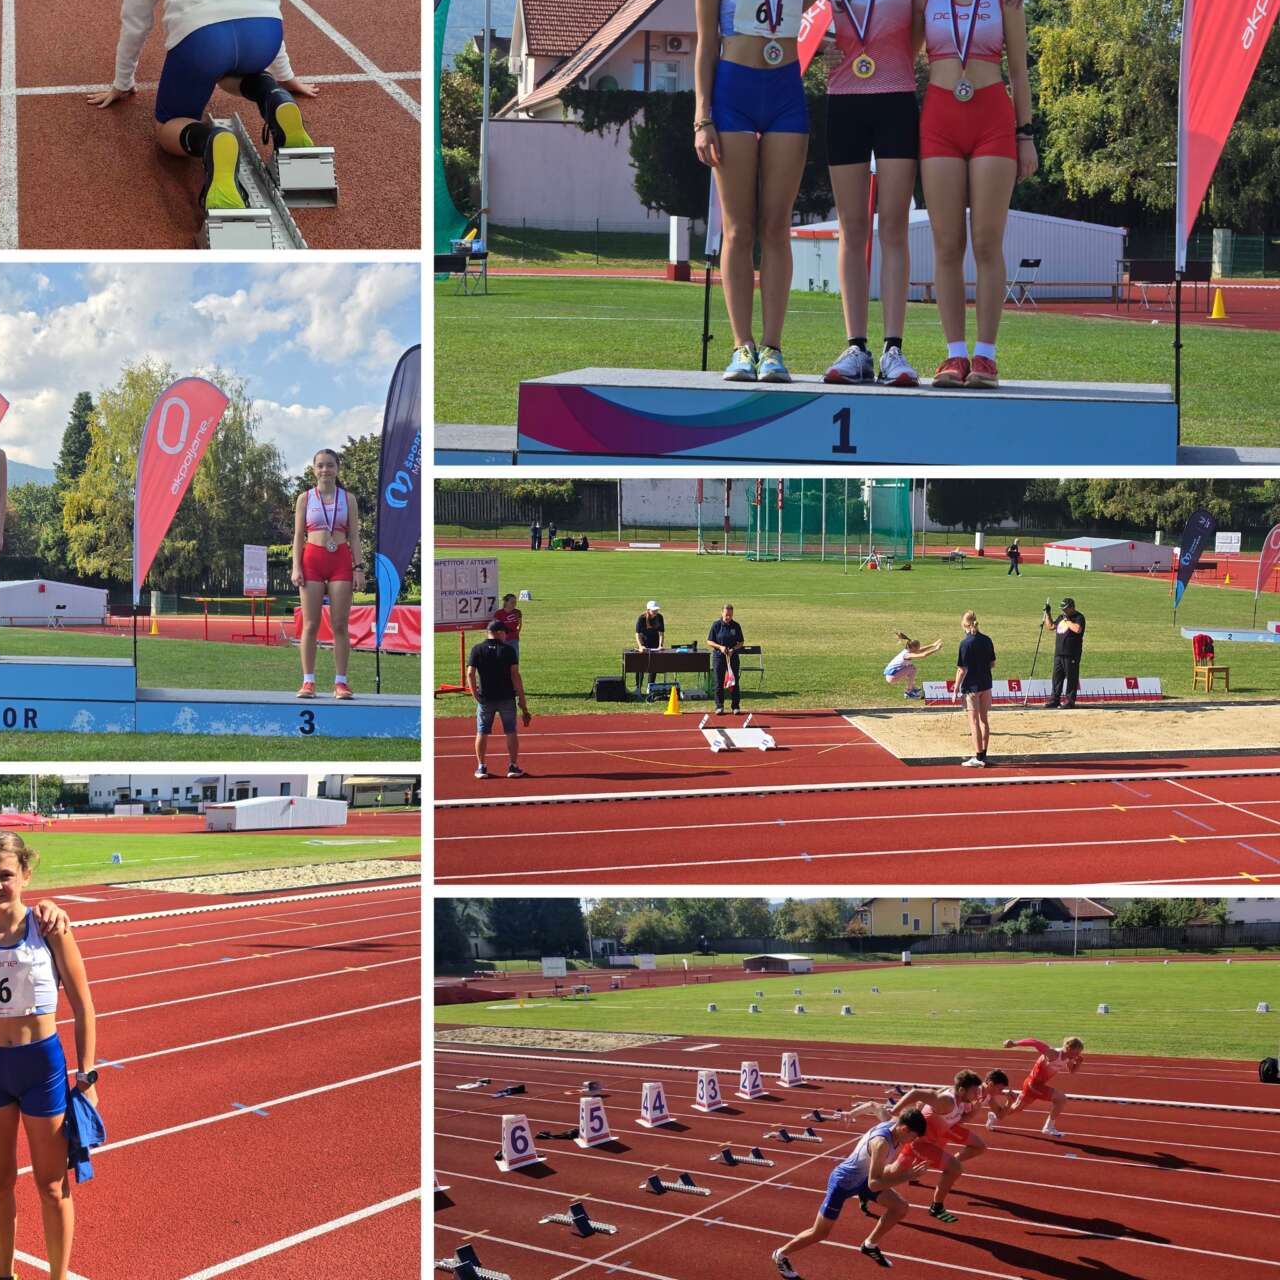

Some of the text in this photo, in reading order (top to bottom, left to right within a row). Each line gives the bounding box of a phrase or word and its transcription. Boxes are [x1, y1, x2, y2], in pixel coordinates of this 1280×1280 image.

[831, 407, 857, 444] 1
[480, 567, 488, 584] 1
[1128, 679, 1135, 688] 7
[299, 710, 317, 734] 3
[750, 1068, 760, 1090] 2
[790, 1058, 798, 1078] 1
[698, 1078, 705, 1101] 3
[707, 1078, 718, 1100] 3
[642, 1091, 649, 1115] 4
[652, 1090, 665, 1114] 4
[589, 1106, 604, 1133] 5
[510, 1125, 529, 1155] 6
